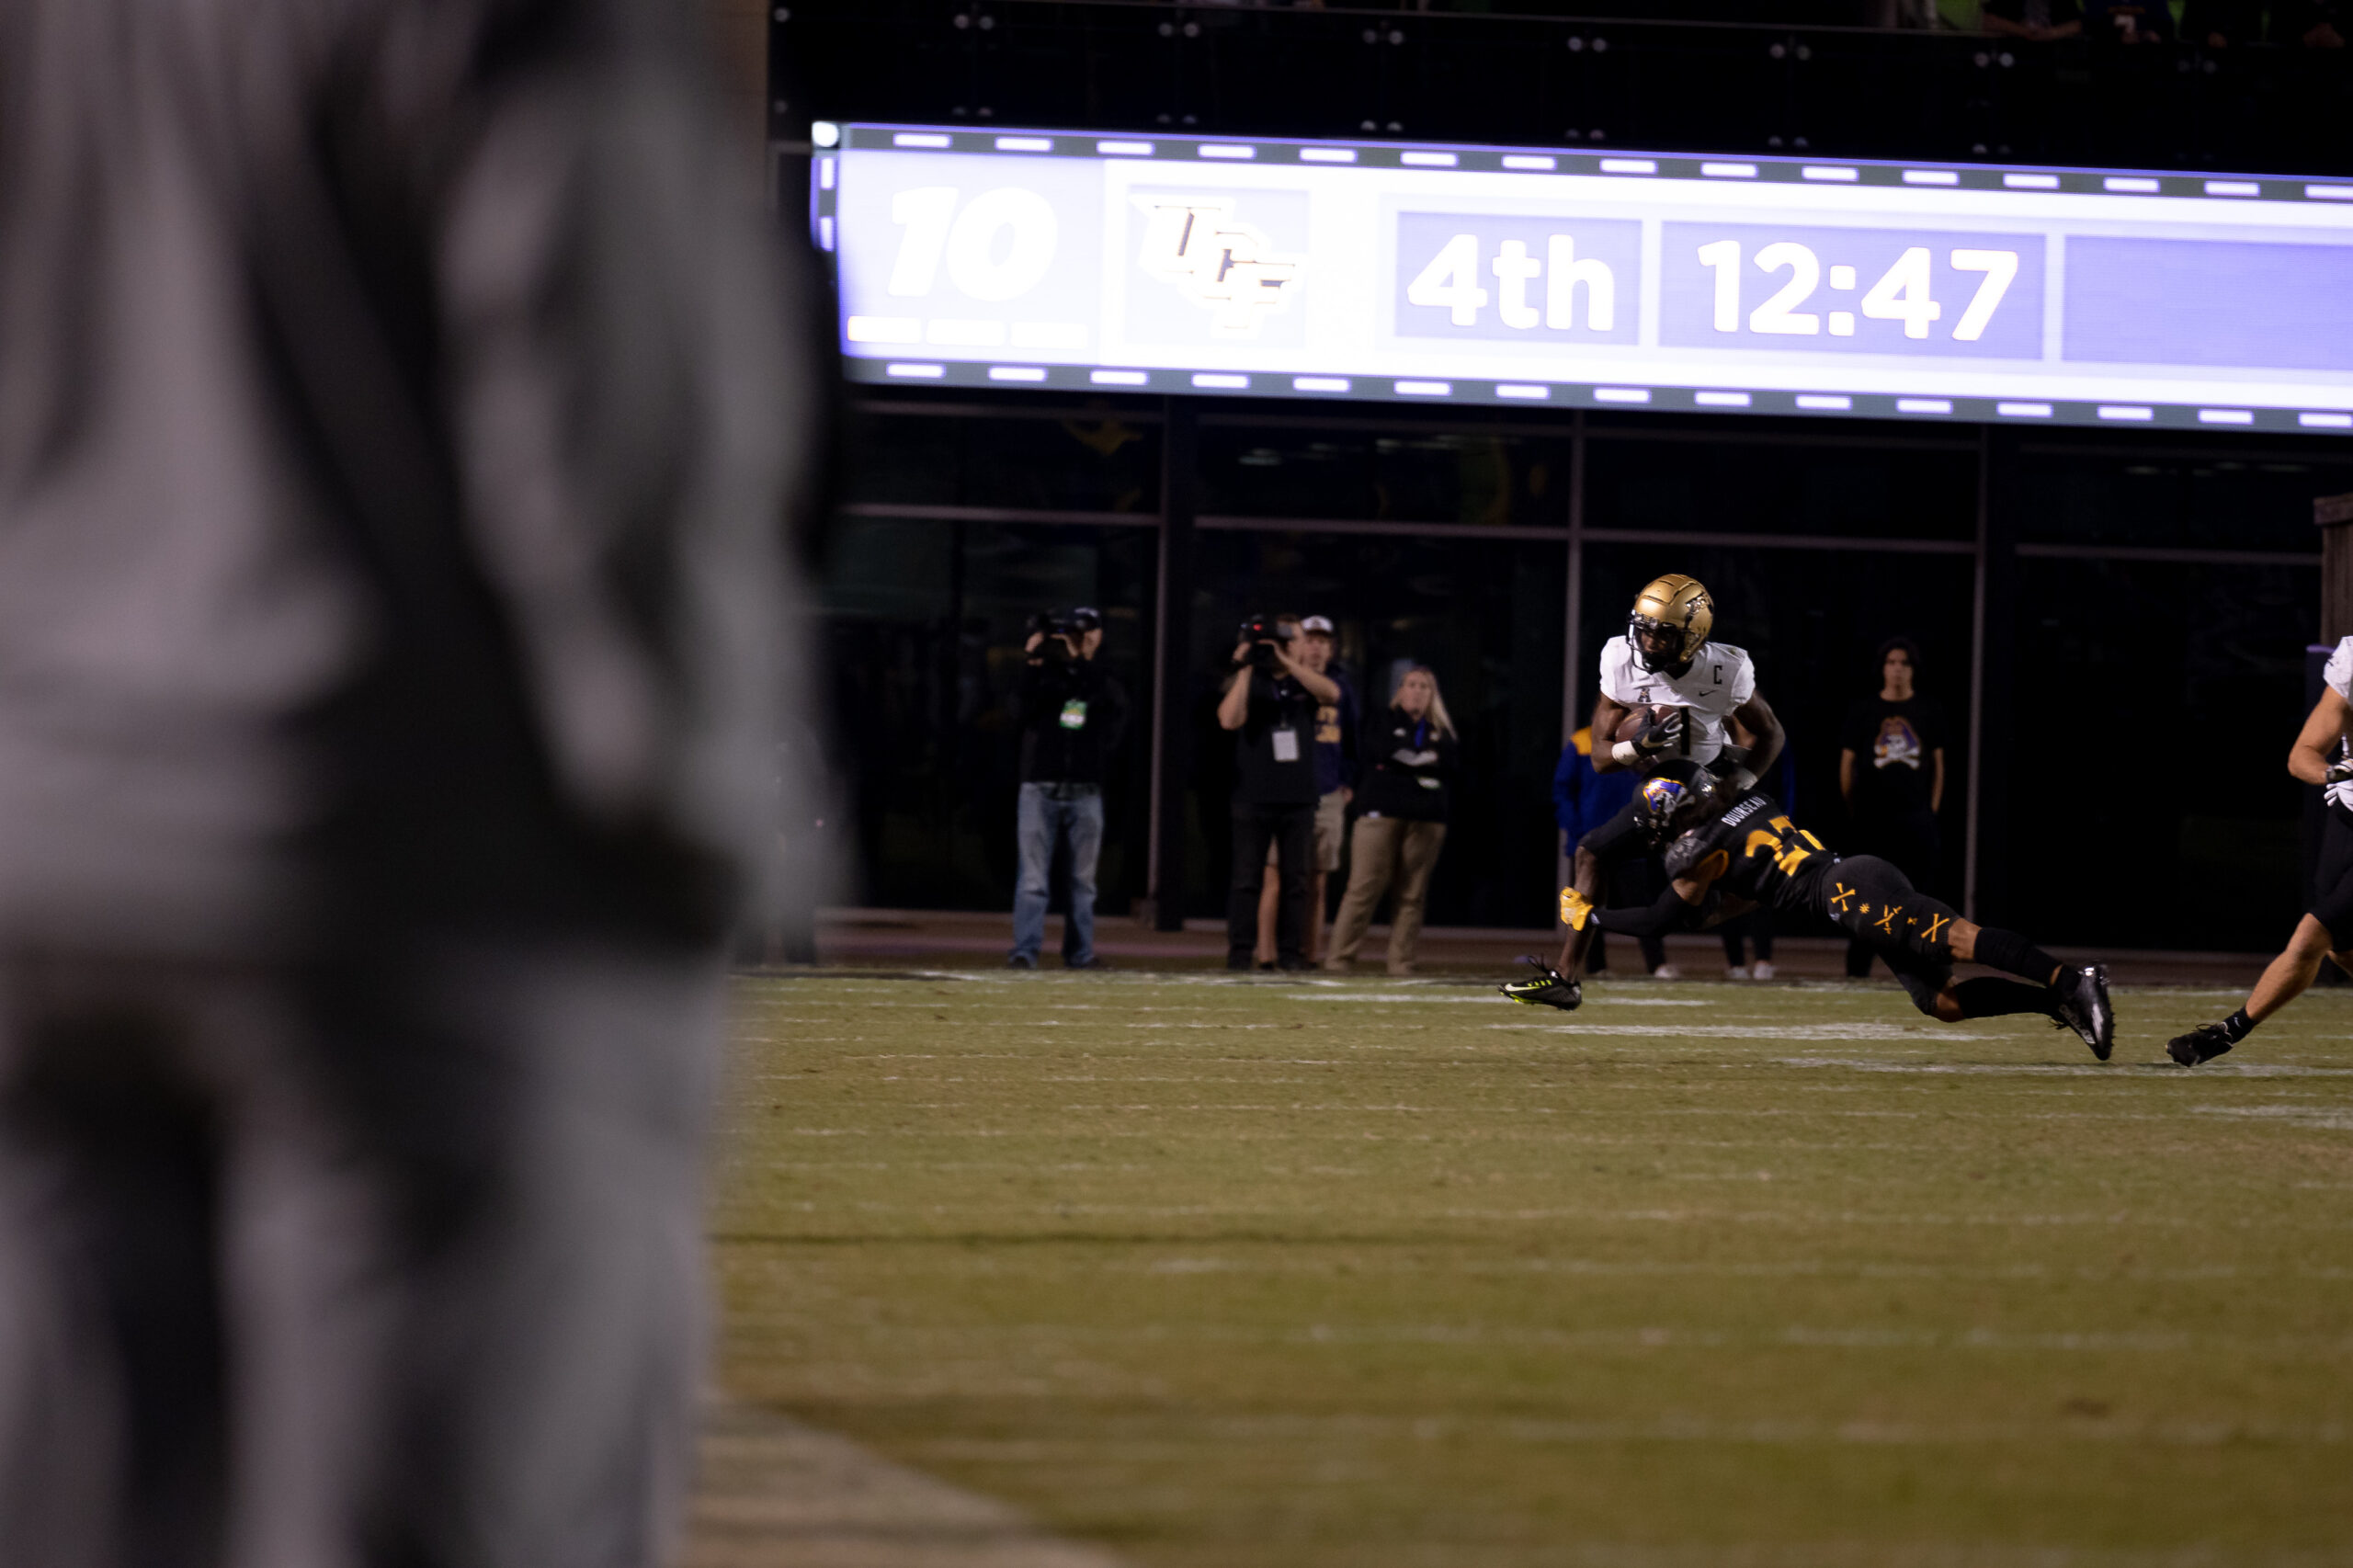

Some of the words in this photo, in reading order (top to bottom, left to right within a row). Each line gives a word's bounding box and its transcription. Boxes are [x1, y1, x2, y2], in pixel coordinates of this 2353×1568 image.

[888, 186, 1058, 301] 10
[1407, 233, 1615, 331] 4th
[1697, 240, 2018, 340] 12:47
[1713, 665, 1722, 685] C
